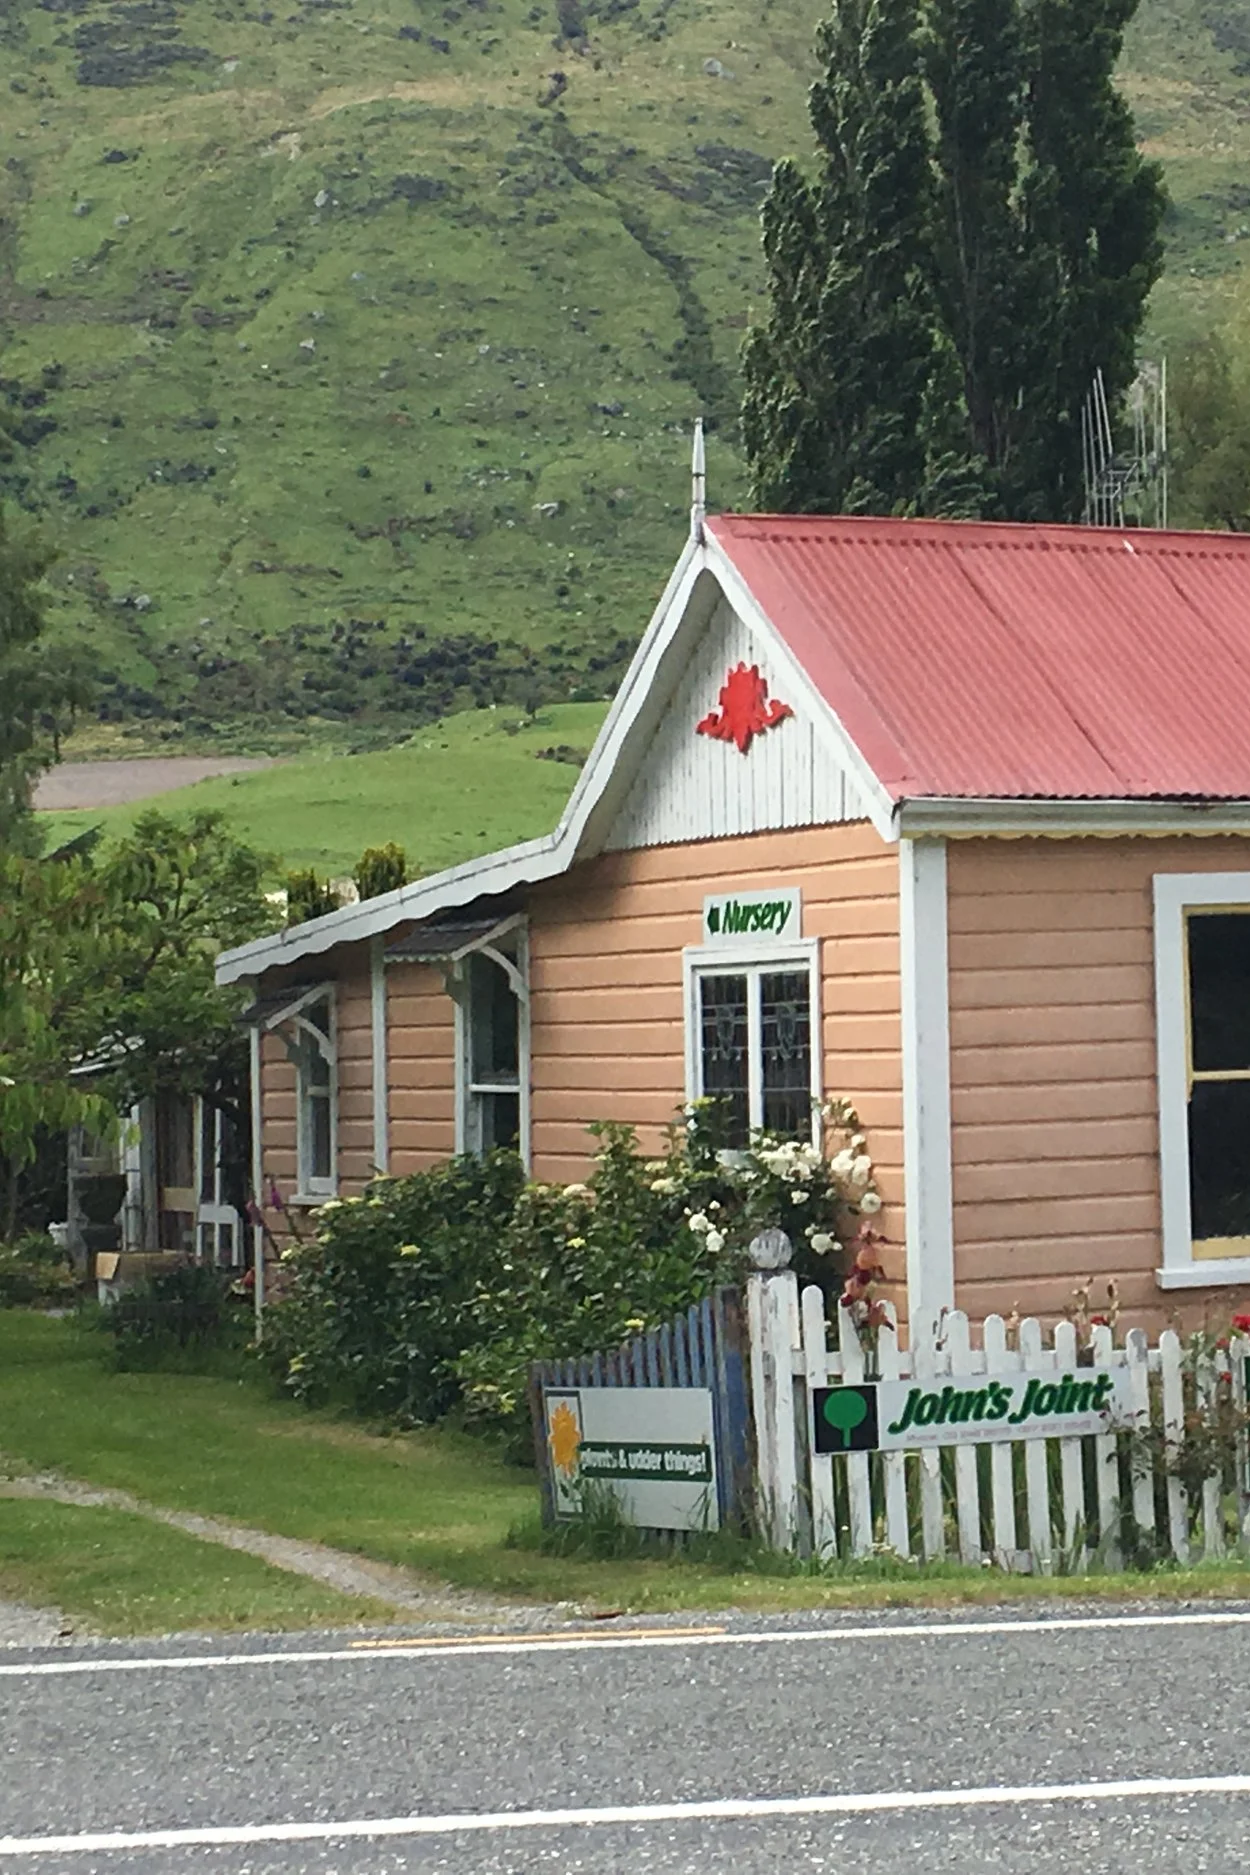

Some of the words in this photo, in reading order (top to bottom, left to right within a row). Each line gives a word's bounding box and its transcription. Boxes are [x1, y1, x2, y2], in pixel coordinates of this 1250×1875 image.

[722, 899, 792, 934] Nursery
[888, 1381, 1013, 1434] John's
[1008, 1373, 1114, 1424] Joint
